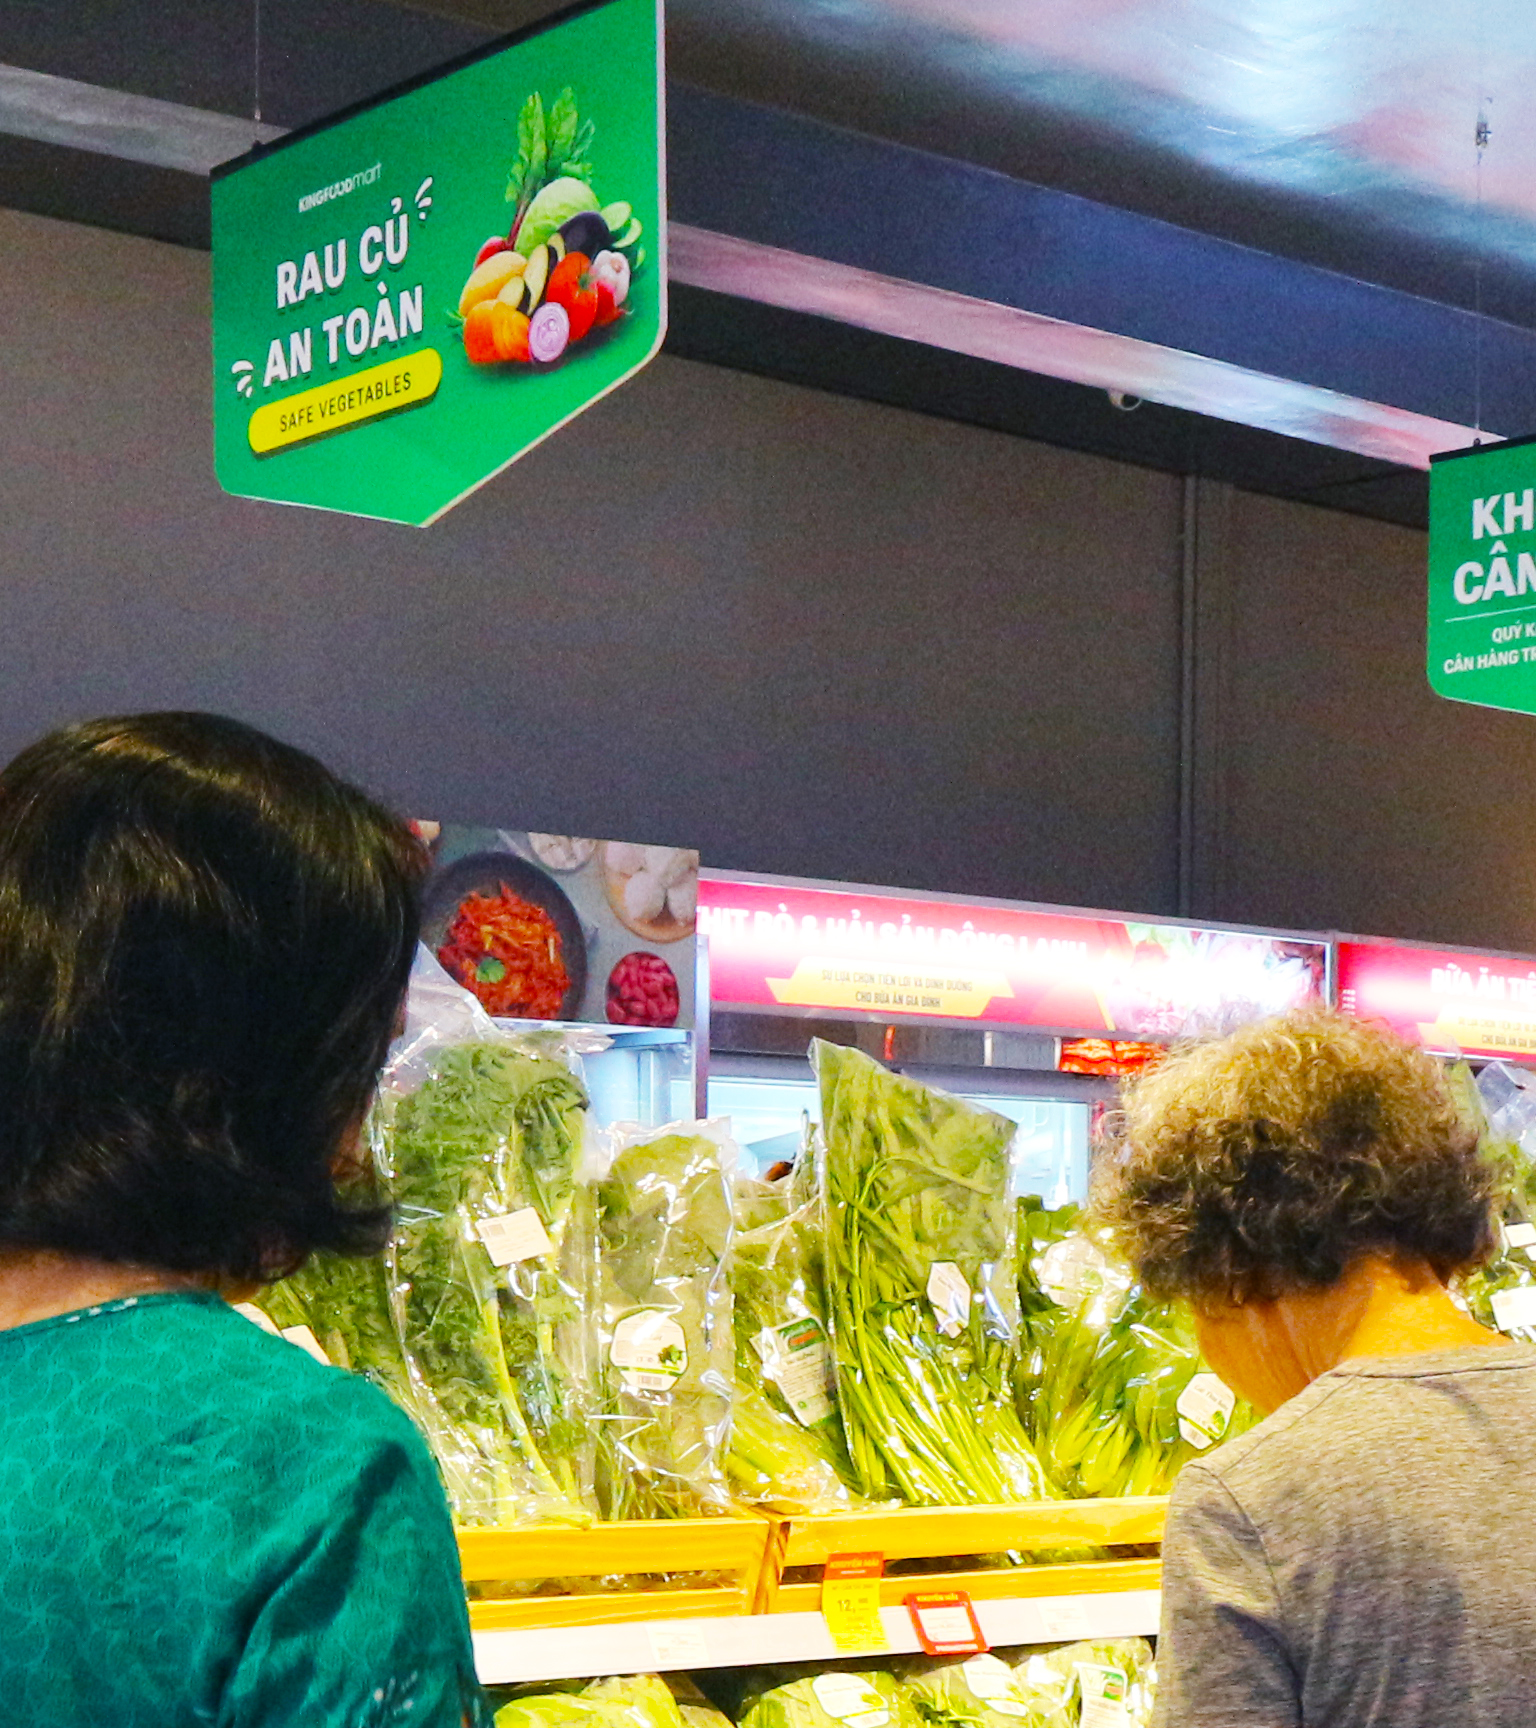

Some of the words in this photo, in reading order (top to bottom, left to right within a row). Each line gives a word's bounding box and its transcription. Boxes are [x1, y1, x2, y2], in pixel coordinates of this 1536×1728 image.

[276, 238, 347, 309] RAU
[358, 197, 409, 275] CỦ
[264, 328, 312, 388] AN
[322, 281, 424, 364] TOÀN
[279, 404, 314, 433] SAFE
[319, 372, 412, 419] VEGETABLES
[1443, 653, 1475, 675] CÂN
[1477, 648, 1519, 669] HÀNG
[1491, 619, 1522, 644] QUÝ
